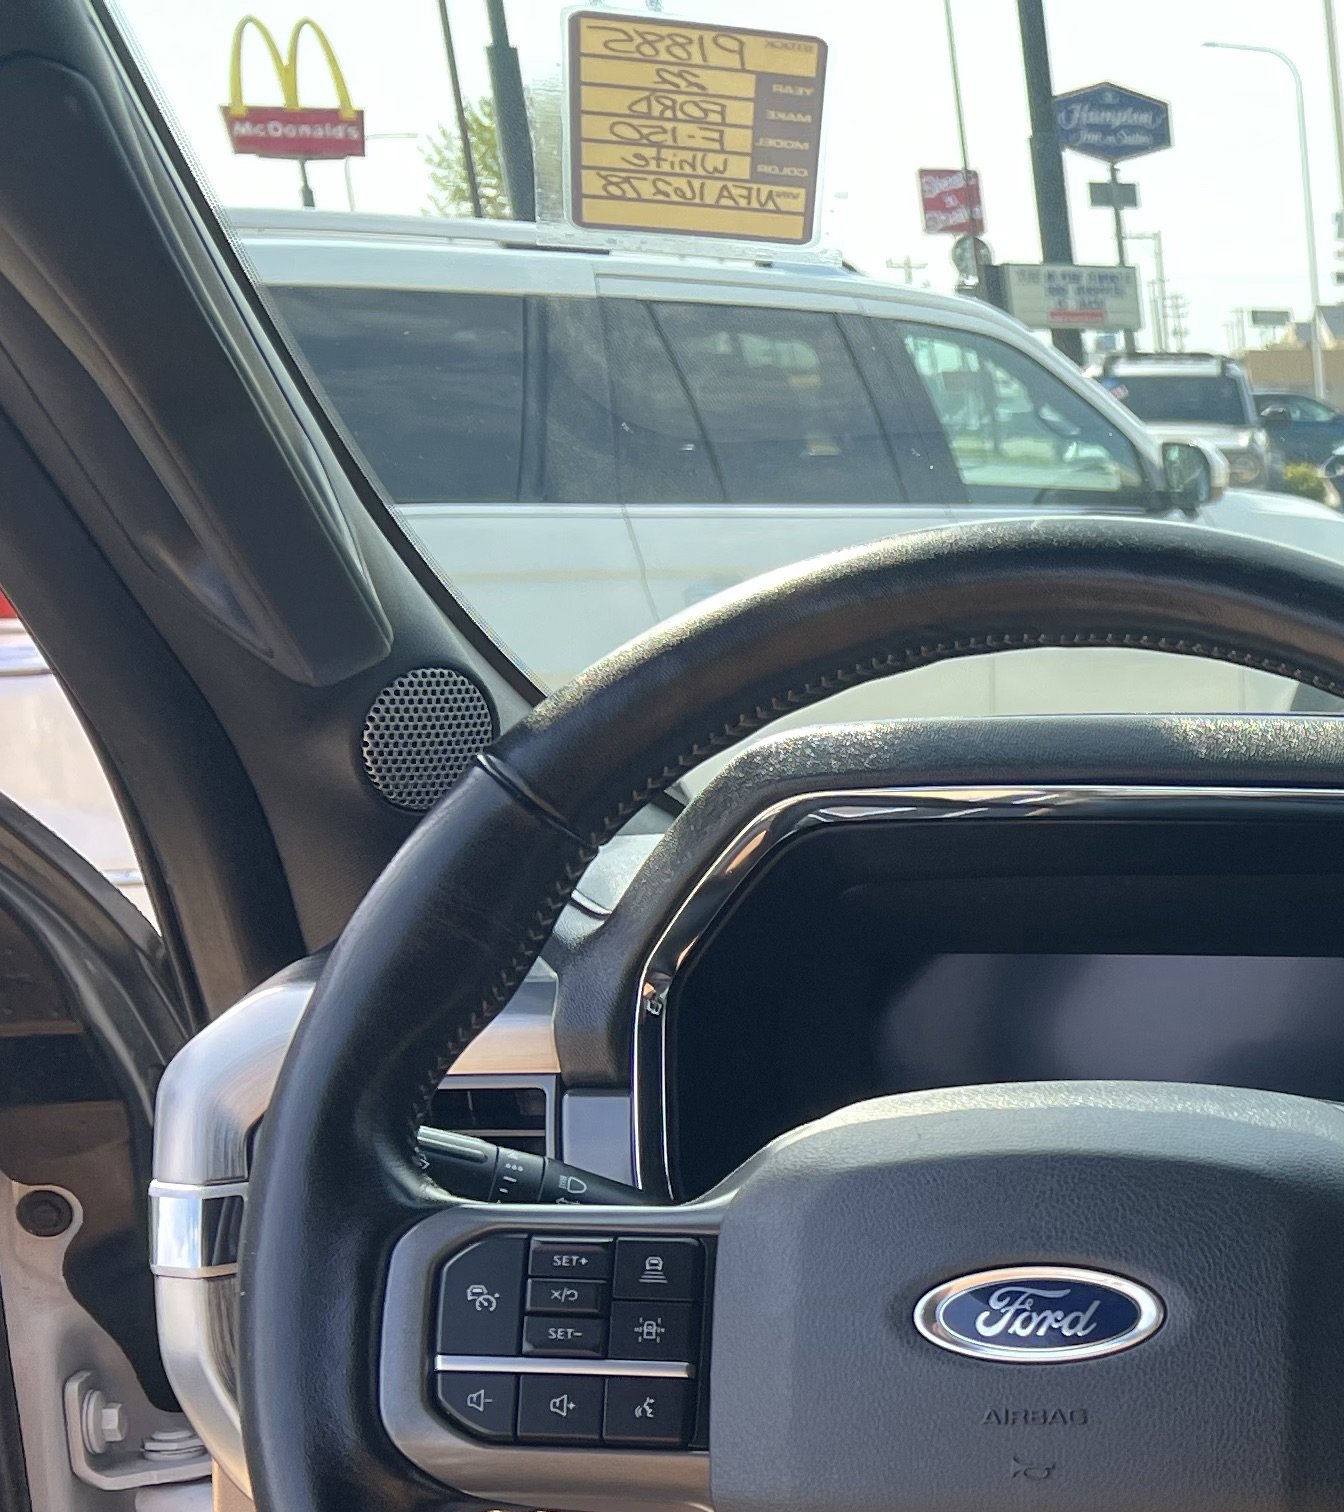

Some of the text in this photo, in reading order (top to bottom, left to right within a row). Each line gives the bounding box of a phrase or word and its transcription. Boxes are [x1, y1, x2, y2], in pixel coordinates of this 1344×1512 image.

[233, 120, 360, 141] McDonald's
[975, 1286, 1101, 1337] Ford
[983, 1408, 1089, 1425] AIRBAG
